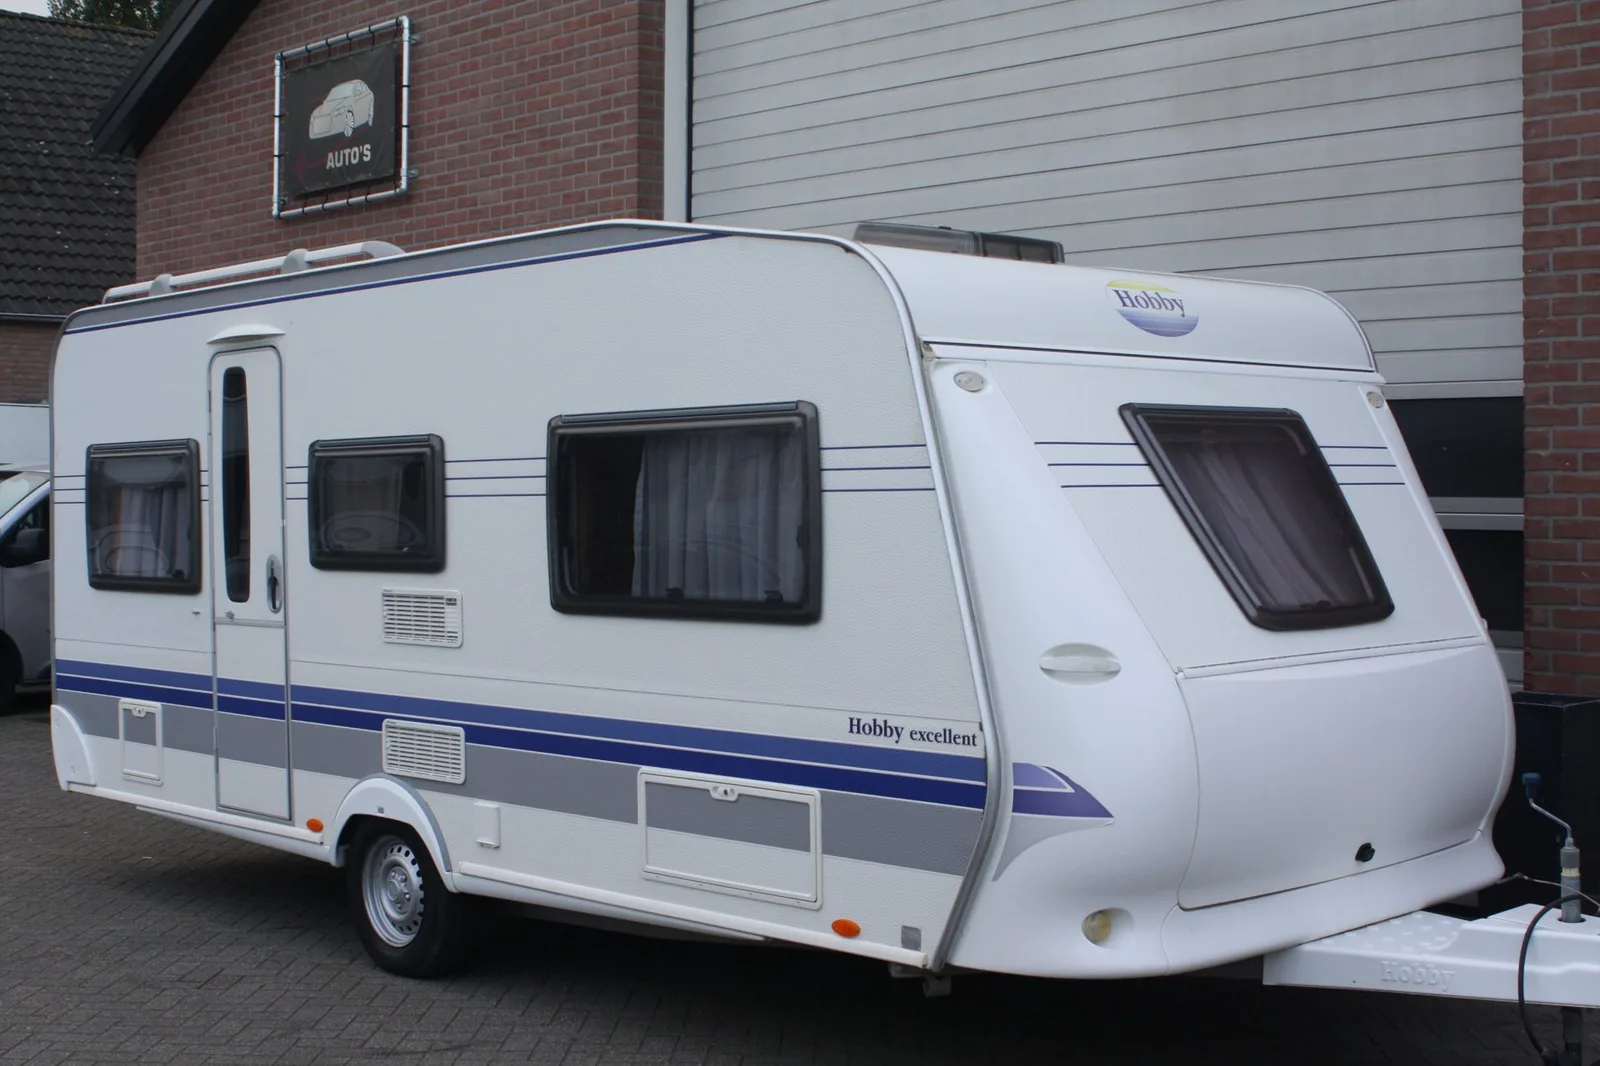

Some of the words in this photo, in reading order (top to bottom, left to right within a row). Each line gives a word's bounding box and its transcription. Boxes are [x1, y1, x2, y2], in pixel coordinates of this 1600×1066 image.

[326, 144, 371, 170] AUTO'S
[1112, 289, 1185, 318] Hobby
[848, 717, 904, 744] Hobby
[909, 728, 977, 747] excellent
[1381, 961, 1455, 992] Hobby
